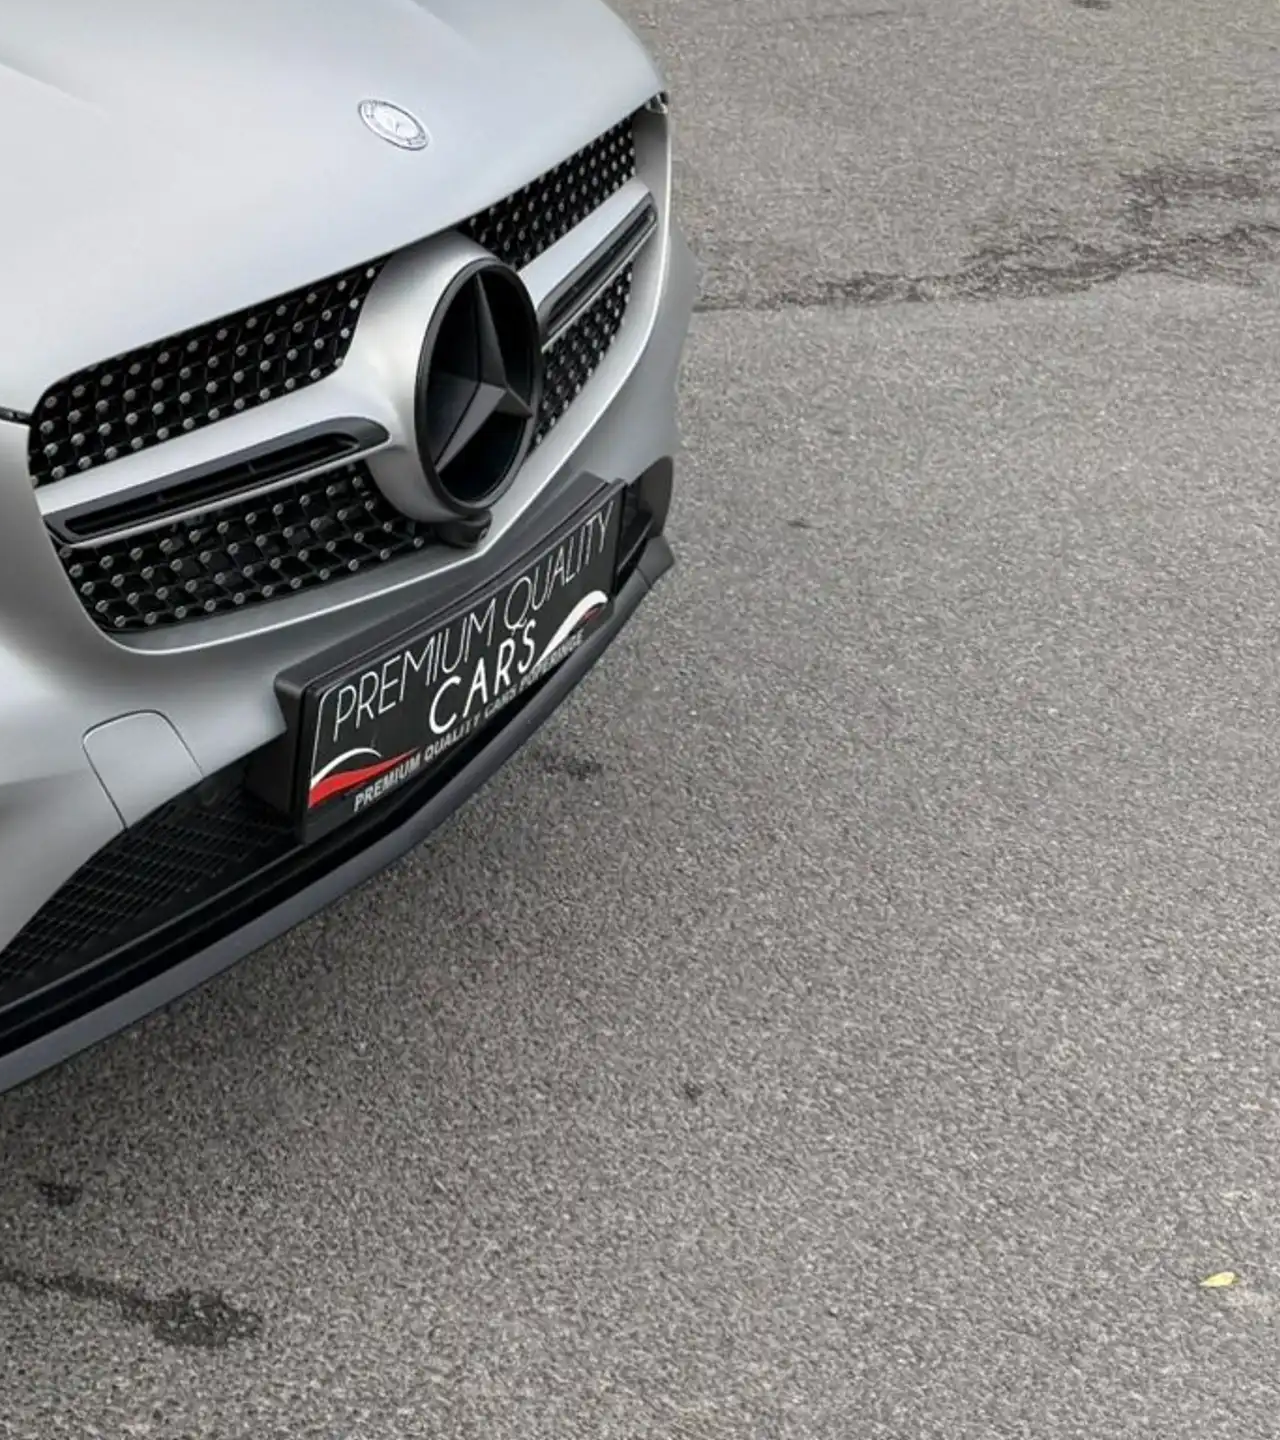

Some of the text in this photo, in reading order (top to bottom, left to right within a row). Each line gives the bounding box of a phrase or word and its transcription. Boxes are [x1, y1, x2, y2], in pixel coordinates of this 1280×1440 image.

[334, 501, 613, 742] PREMIUM QUALITY
[429, 620, 537, 734] CARS
[354, 752, 422, 812] PREMIUM
[425, 713, 481, 763] QUALITY
